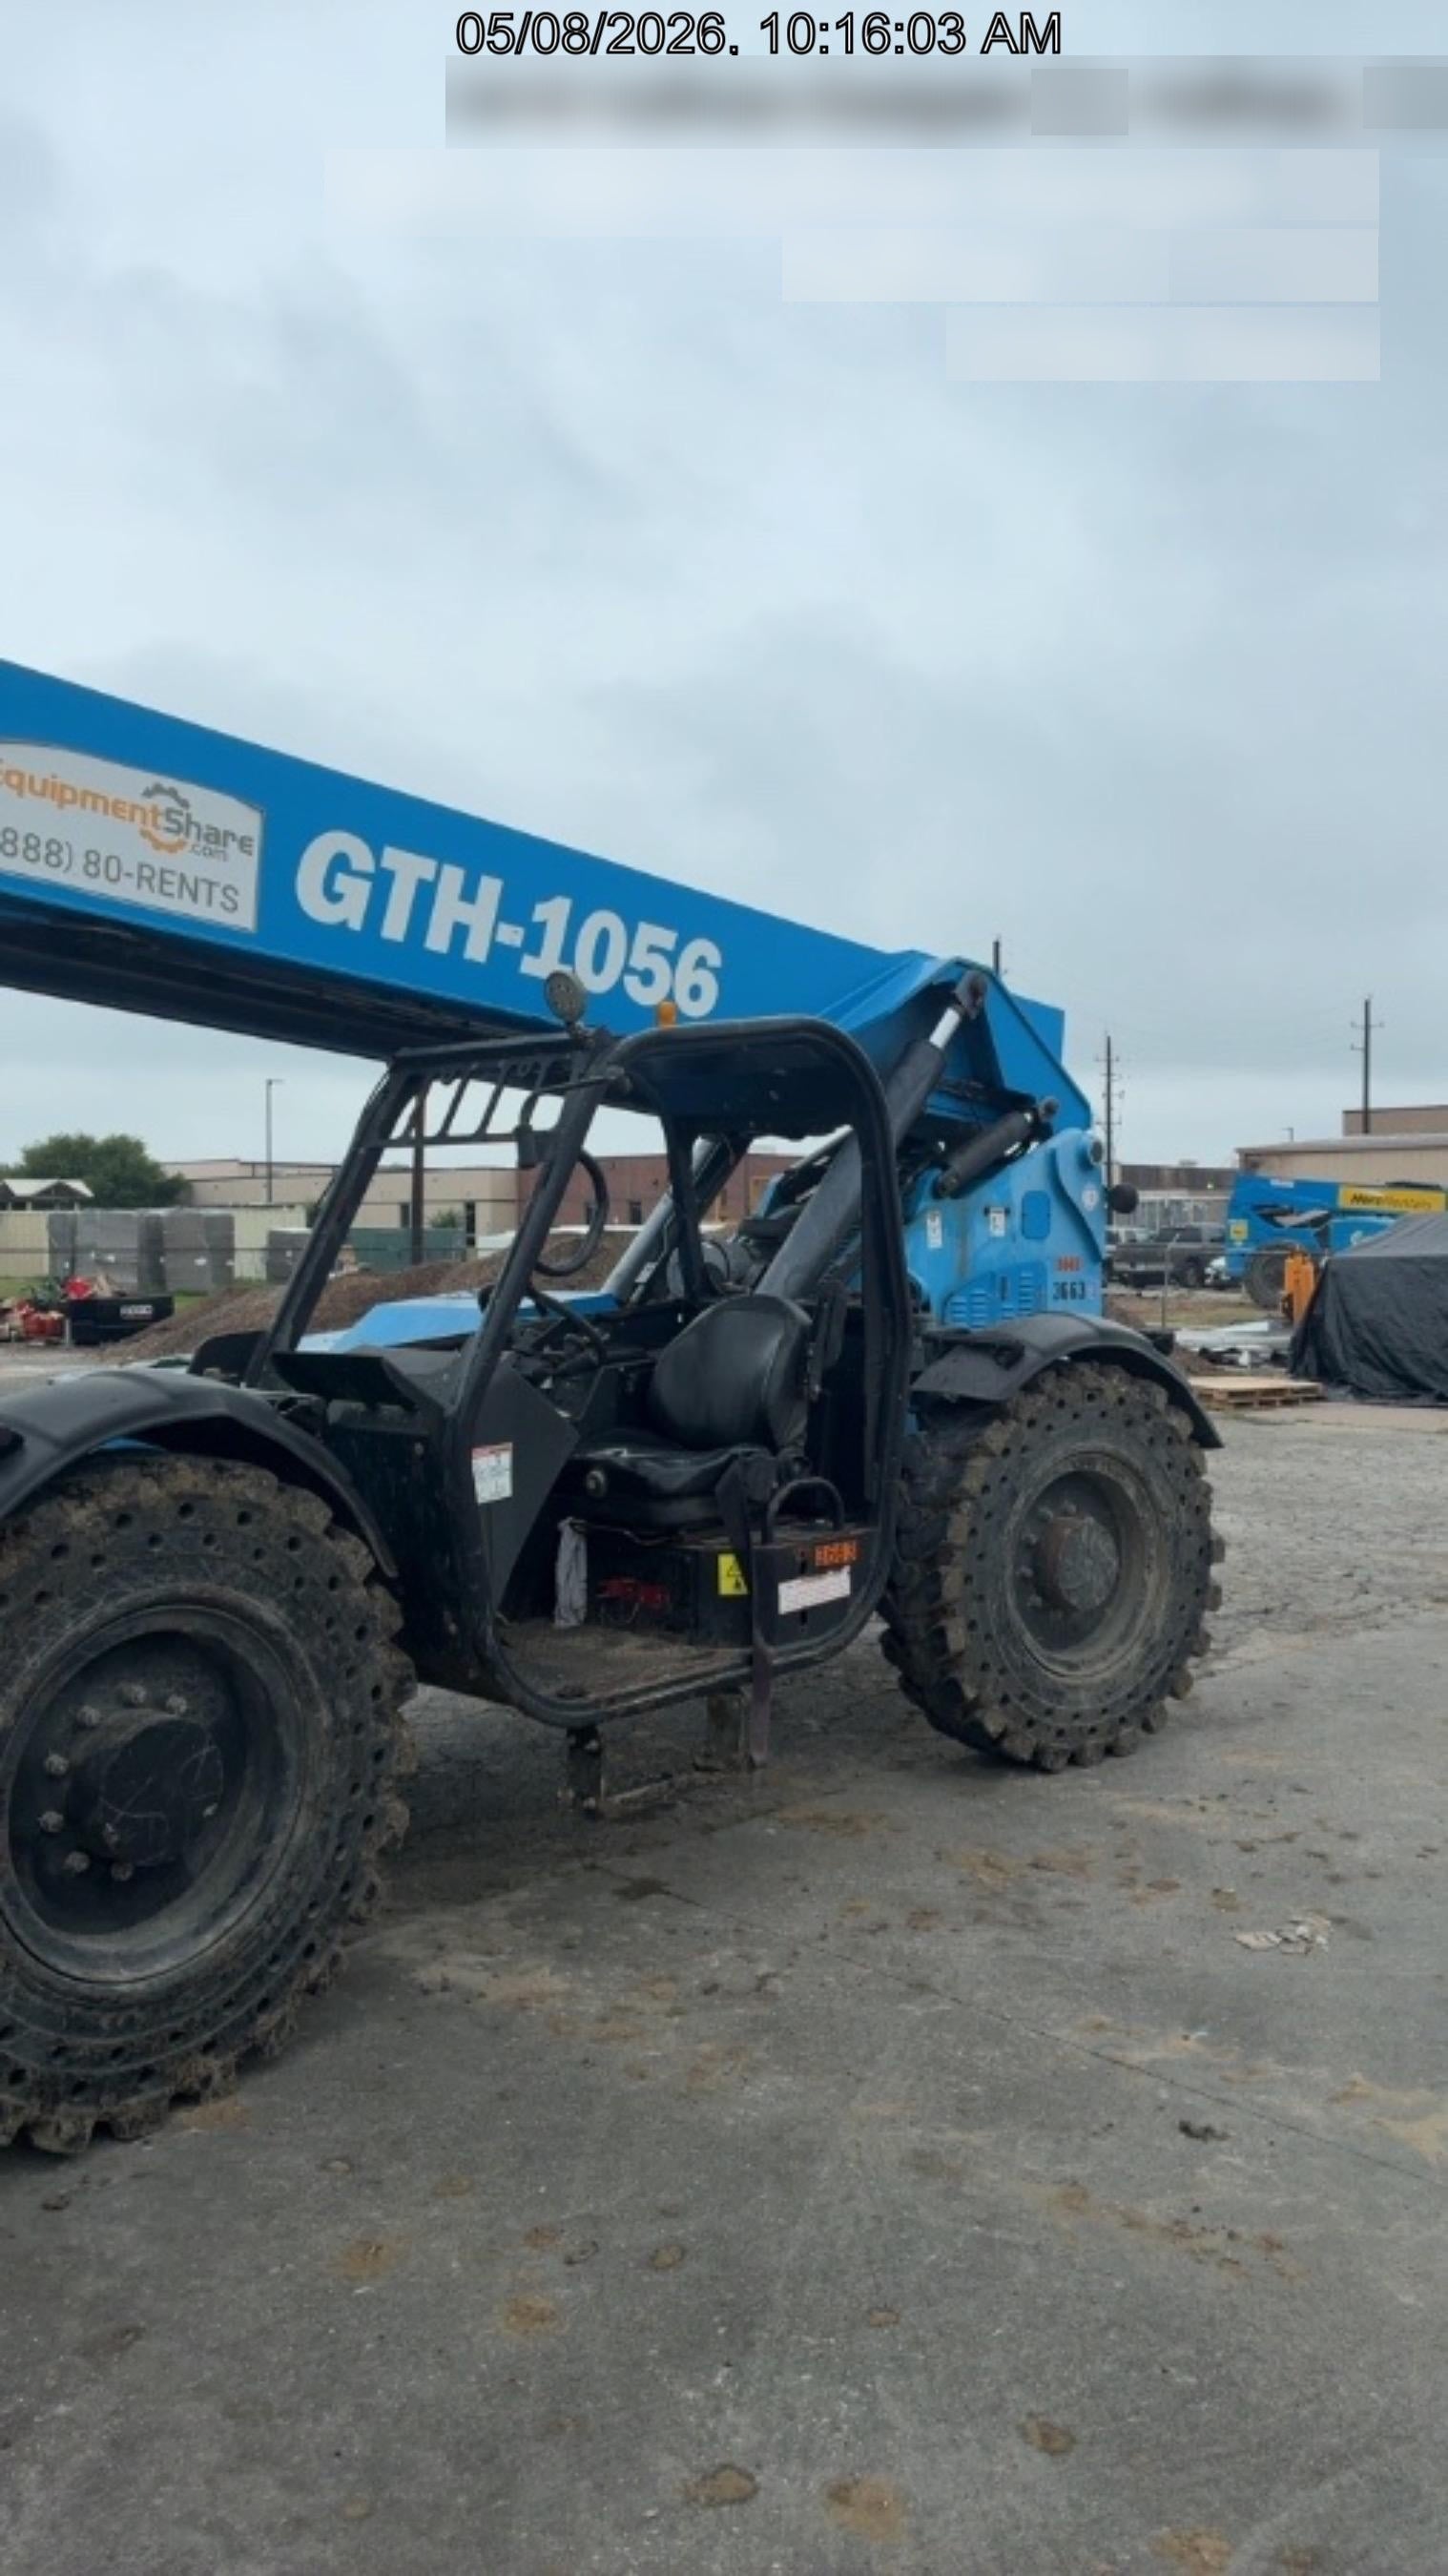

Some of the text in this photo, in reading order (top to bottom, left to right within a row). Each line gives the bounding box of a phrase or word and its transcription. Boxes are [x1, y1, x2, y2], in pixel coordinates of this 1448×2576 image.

[0, 768, 255, 857] quipmentShare
[83, 849, 240, 914] 80-RENTS
[295, 829, 723, 1018] GTH-1056
